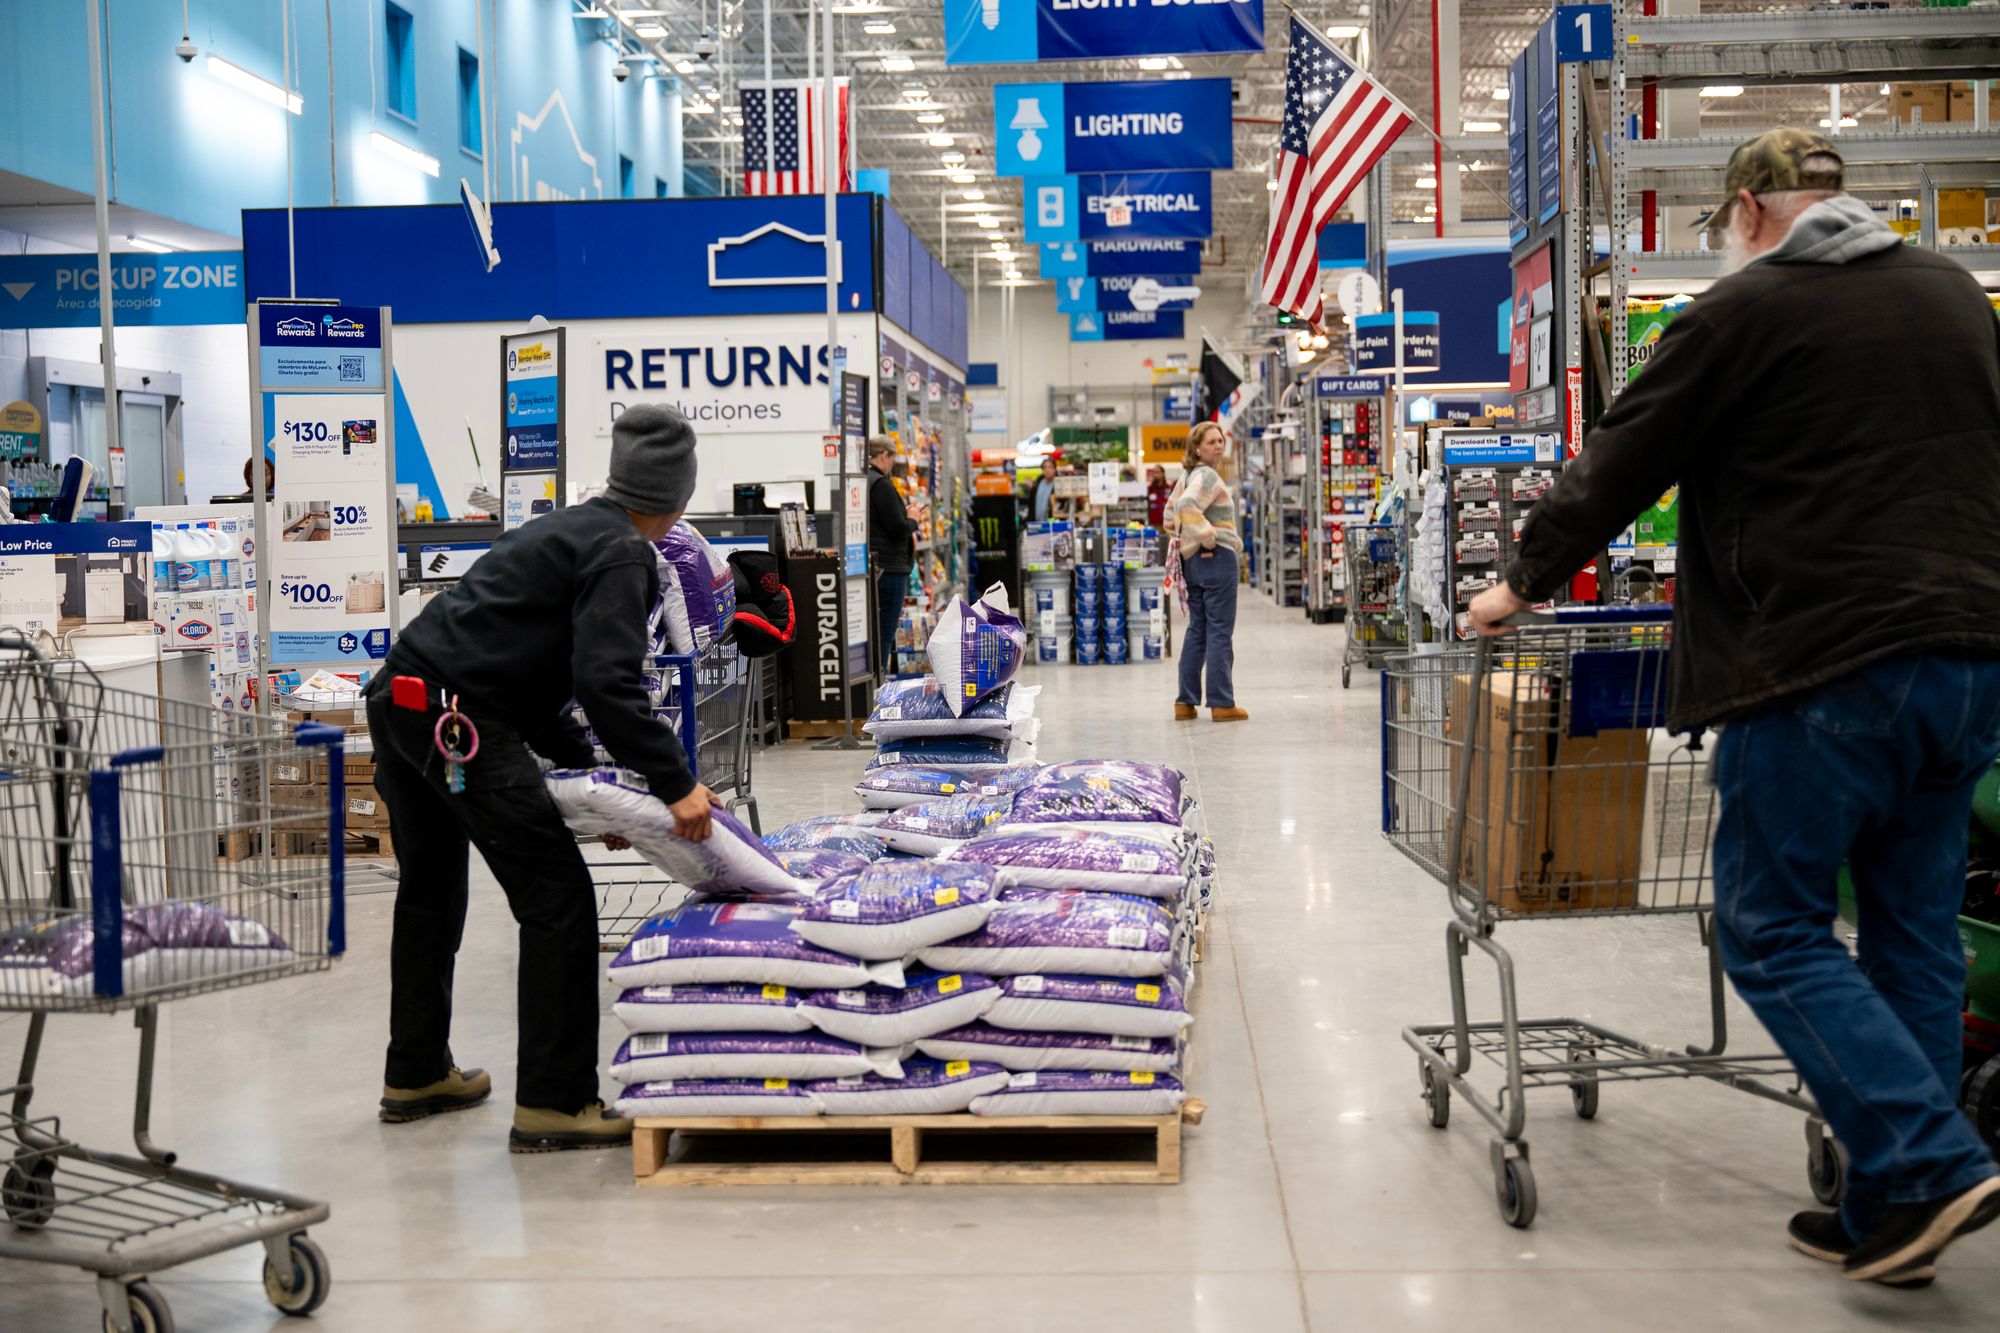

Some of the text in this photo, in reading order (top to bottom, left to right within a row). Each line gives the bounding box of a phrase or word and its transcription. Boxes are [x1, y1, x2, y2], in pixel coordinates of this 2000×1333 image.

[1575, 13, 1592, 52] 1
[1075, 113, 1183, 137] LIGHTING
[1093, 241, 1185, 252] HARDWARE
[163, 265, 237, 289] ZONE
[56, 296, 85, 309] Área
[112, 296, 161, 311] ecogida
[1108, 312, 1157, 324] LUMBER
[277, 328, 315, 337] Rewards
[328, 328, 365, 337] Rewards
[1366, 337, 1388, 347] Paint
[1414, 348, 1433, 358] Here
[1322, 381, 1379, 391] GIFT CARDS
[611, 399, 782, 423] Dluciones
[284, 421, 328, 441] $130
[0, 435, 23, 451] RENT
[508, 500, 522, 512] Digital
[507, 514, 524, 524] badges
[0, 540, 52, 551] Low Price
[280, 582, 331, 602] $100
[182, 625, 208, 635] CLOROX
[341, 637, 355, 647] 5x
[816, 573, 837, 701] DURACELL
